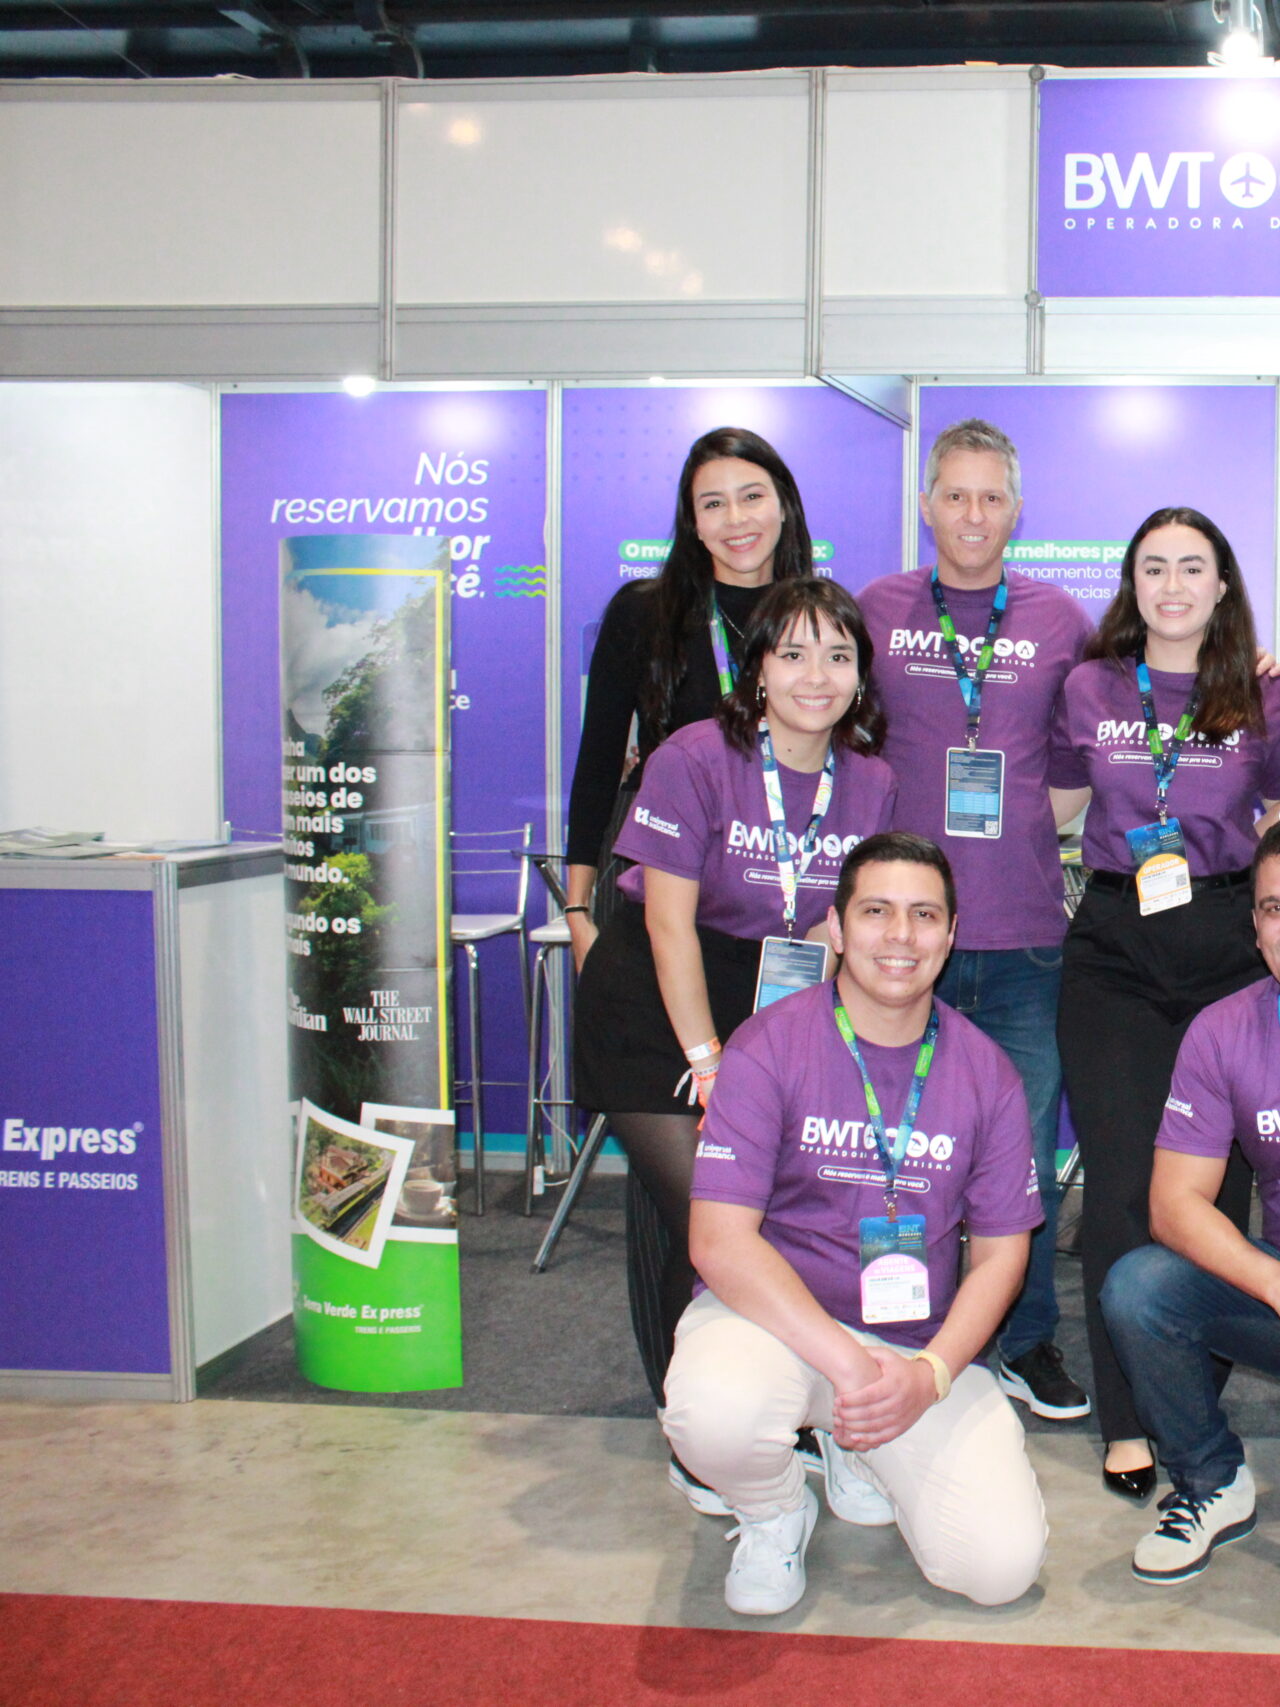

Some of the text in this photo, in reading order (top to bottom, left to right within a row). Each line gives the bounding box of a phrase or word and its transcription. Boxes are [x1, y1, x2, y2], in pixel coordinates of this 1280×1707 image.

[1064, 152, 1214, 209] BWT
[1064, 216, 1244, 230] OPERADORA
[415, 451, 490, 485] Nós
[270, 496, 490, 524] reservamos
[1014, 543, 1101, 559] melhores
[888, 650, 947, 659] OPERADOR
[993, 659, 1035, 668] URISMO
[296, 765, 326, 782] um
[329, 761, 377, 783] dos
[330, 786, 363, 809] de
[296, 811, 344, 833] mais
[331, 917, 361, 935] os
[370, 990, 399, 1007] THE
[343, 1007, 433, 1024] WALL STREET
[801, 1115, 865, 1149] BWT
[904, 1159, 952, 1172] URISMO
[0, 1170, 139, 1191] RENS E PASSEIOS
[324, 1302, 357, 1319] Verde
